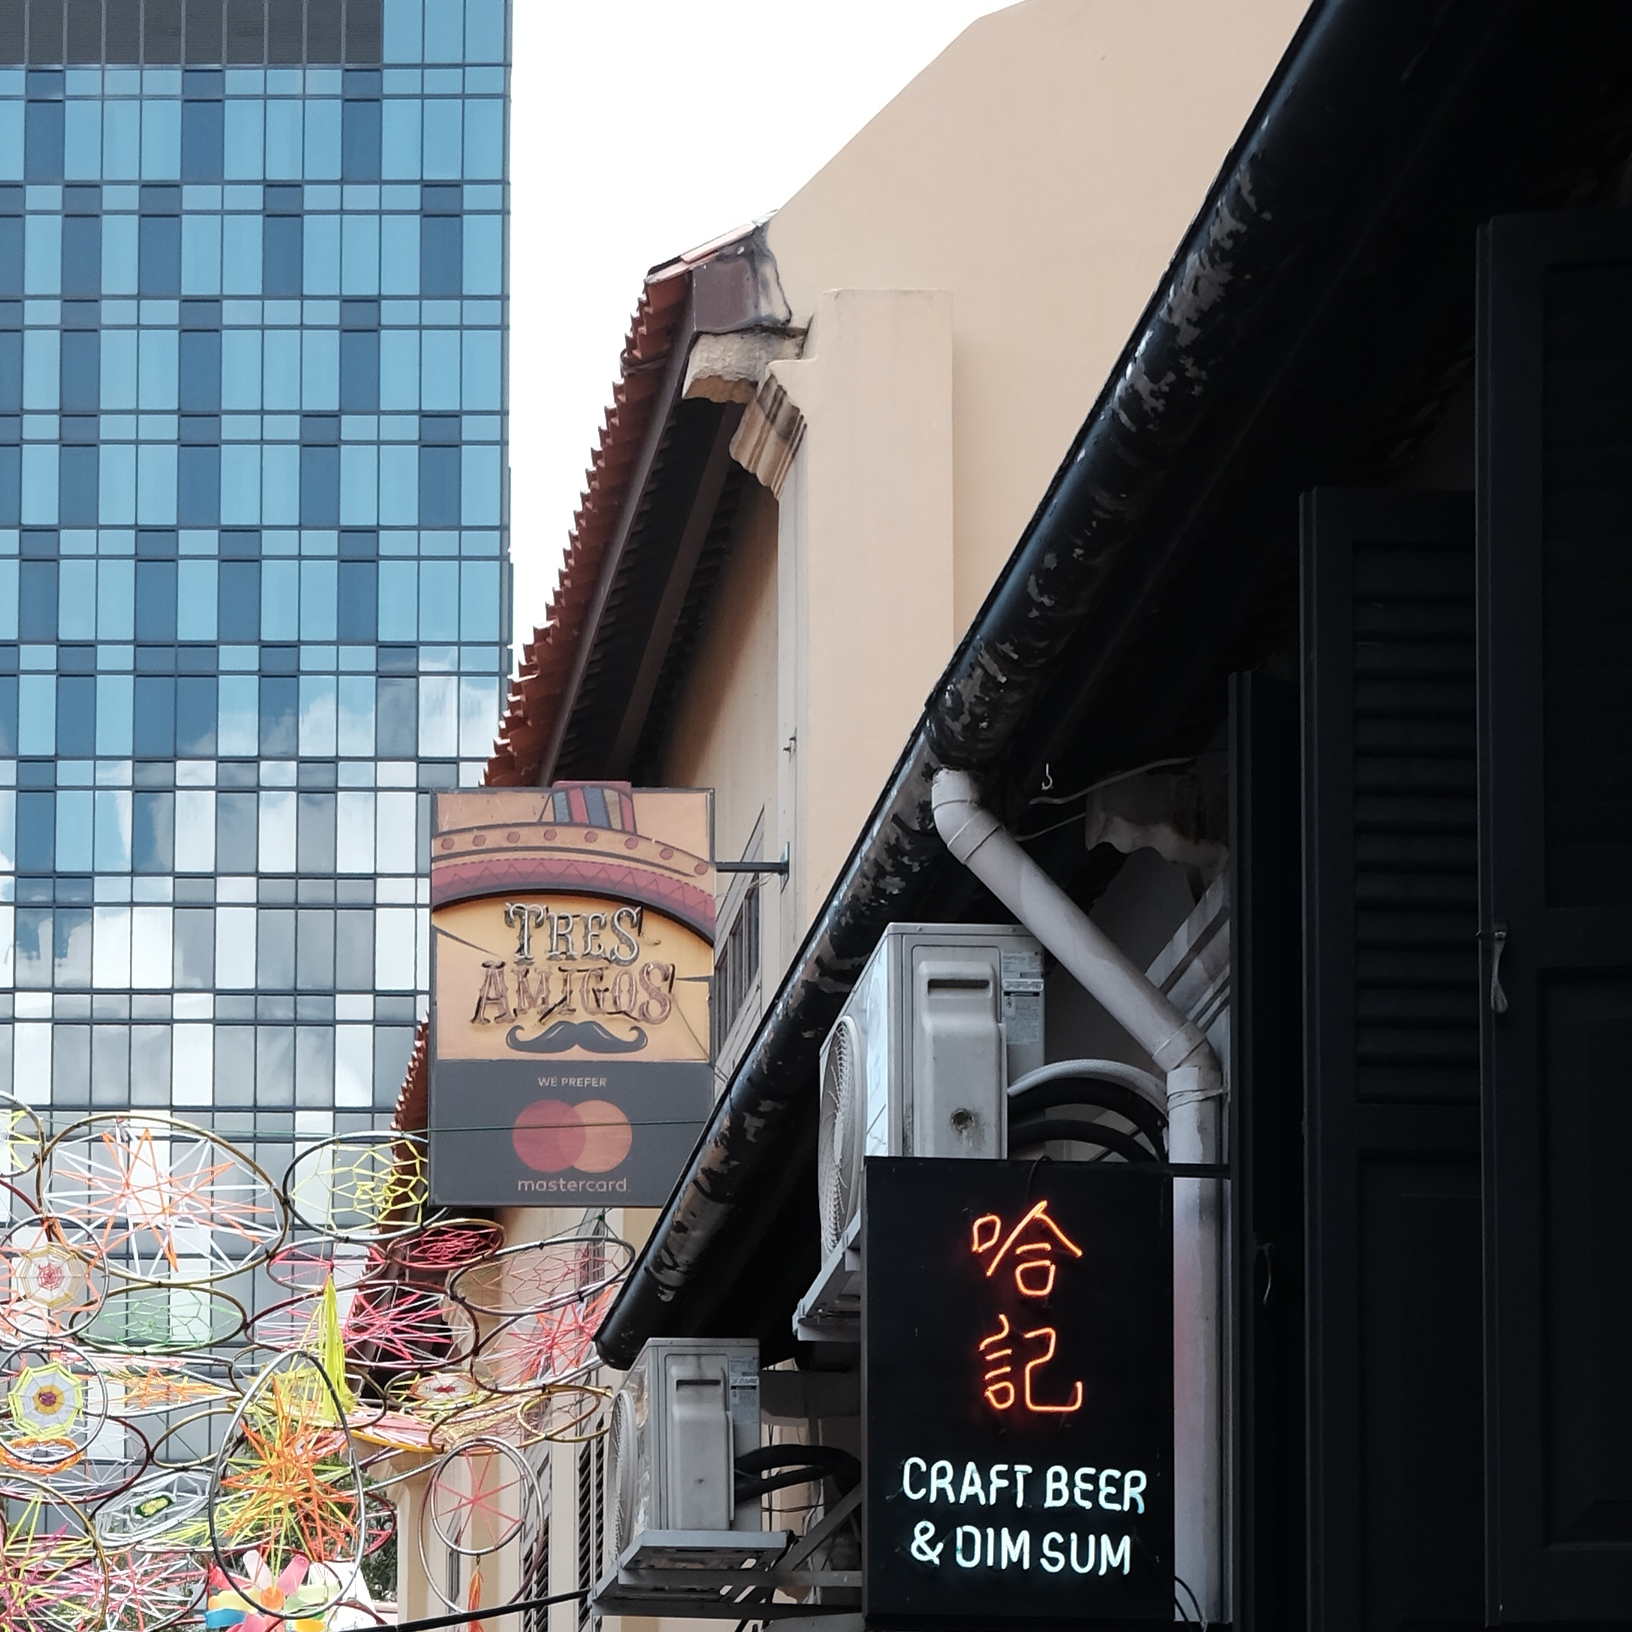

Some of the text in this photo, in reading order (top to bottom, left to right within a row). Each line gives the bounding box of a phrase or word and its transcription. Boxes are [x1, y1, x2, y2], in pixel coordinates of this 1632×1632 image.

[470, 961, 676, 1026] AMIGOS
[537, 1076, 608, 1088] WE PREFER
[517, 1177, 627, 1193] mastercard
[902, 1456, 1148, 1515] CRAFT BEER
[910, 1520, 1132, 1576] & DIM SUM
